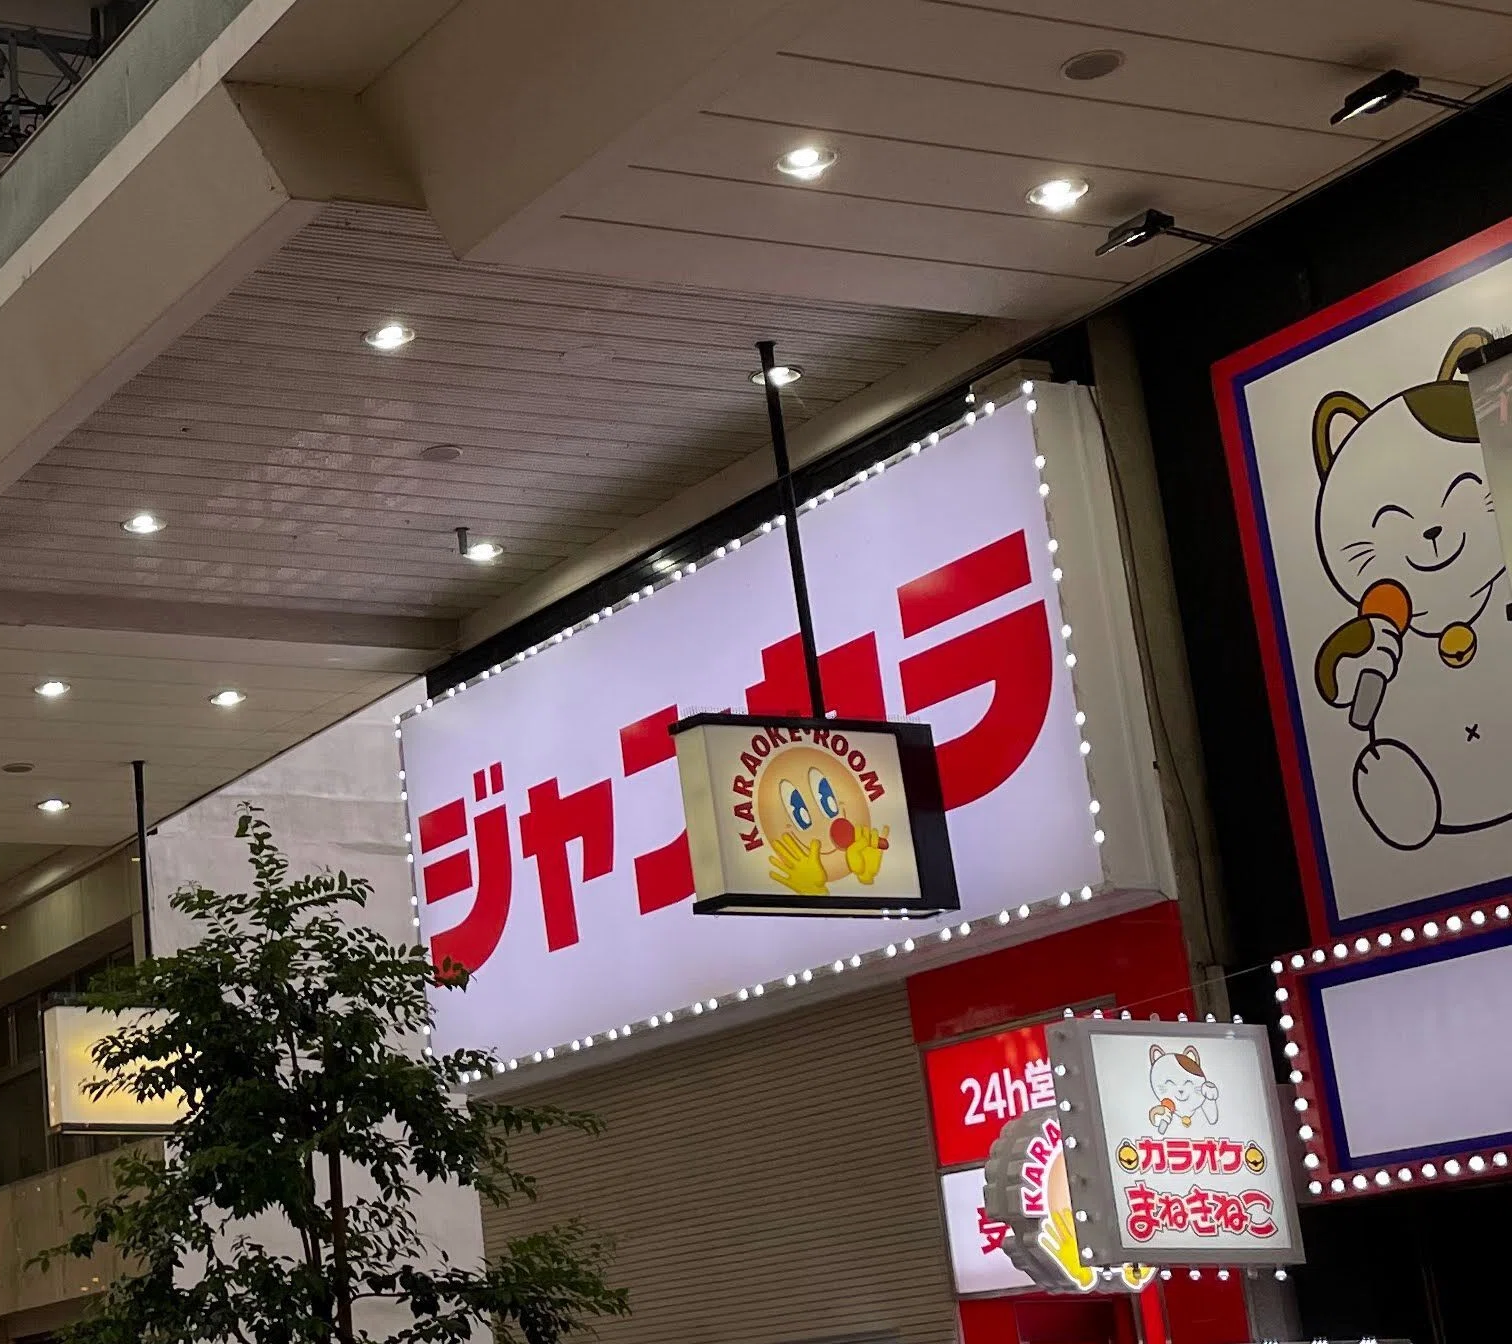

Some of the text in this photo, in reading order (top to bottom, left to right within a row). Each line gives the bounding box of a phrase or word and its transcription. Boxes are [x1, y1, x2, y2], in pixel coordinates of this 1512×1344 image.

[1138, 1138, 1245, 1174] カラオケ
[1124, 1180, 1279, 1243] まねきねこ
